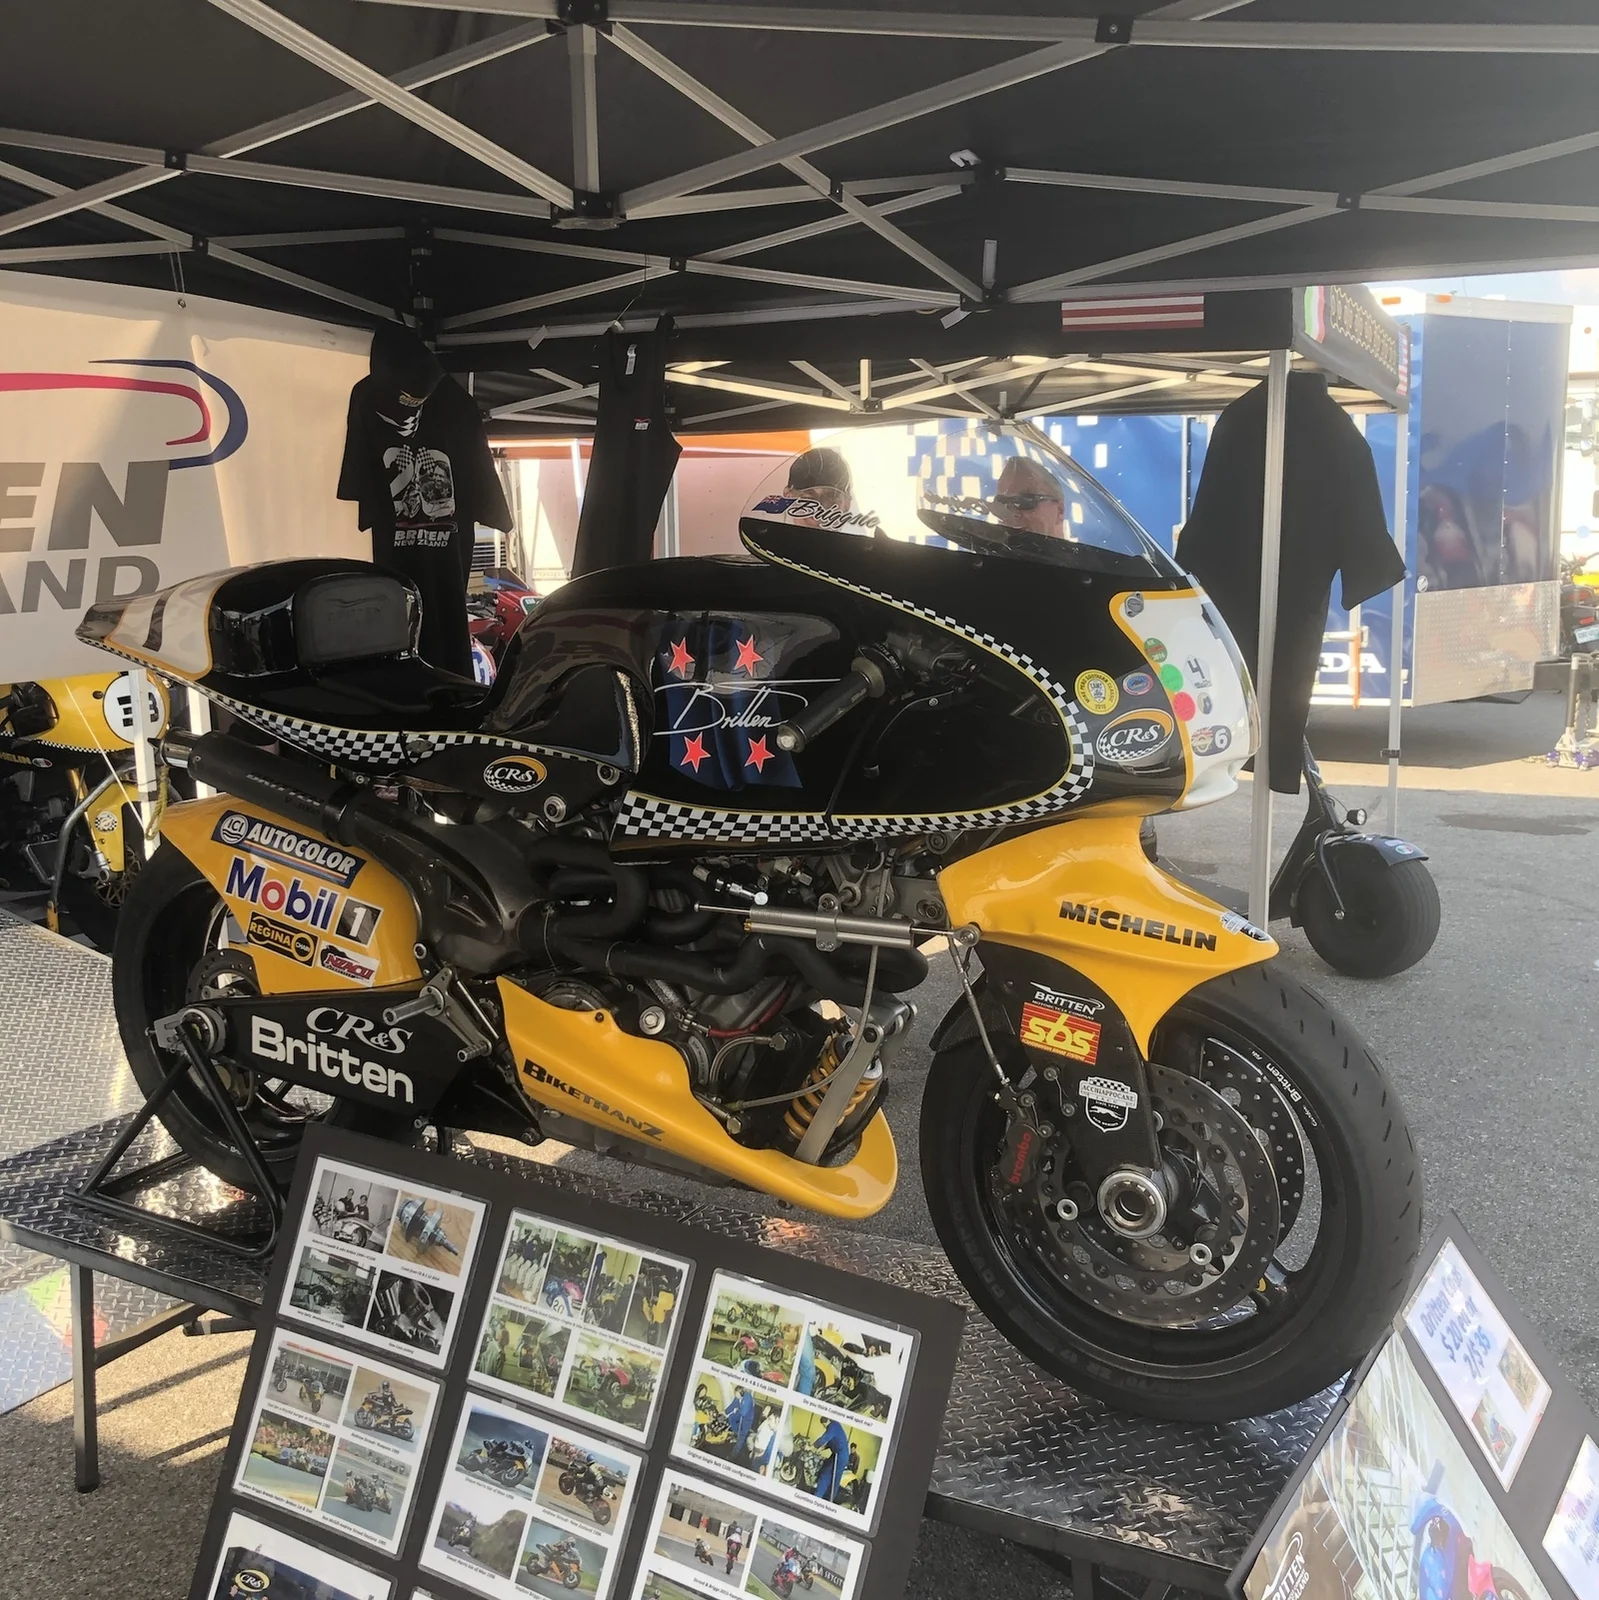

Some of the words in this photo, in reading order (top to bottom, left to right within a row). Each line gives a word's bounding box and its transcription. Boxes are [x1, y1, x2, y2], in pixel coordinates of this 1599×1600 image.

[787, 499, 881, 530] Briggsie
[1110, 724, 1160, 747] CR&S
[494, 766, 535, 782] CR&S
[227, 818, 243, 832] ICI
[247, 822, 357, 874] AUTOCOLOR
[226, 857, 338, 931] Mobil
[349, 905, 368, 937] 1
[250, 920, 292, 946] REGINA
[1058, 900, 1217, 952] MICHELIN
[1034, 991, 1096, 1015] BRITTEN
[305, 1006, 414, 1054] CR&S
[251, 1014, 414, 1104] Britten
[1008, 1131, 1031, 1184] brembo
[816, 1403, 828, 1411] think
[731, 1467, 756, 1482] configuration
